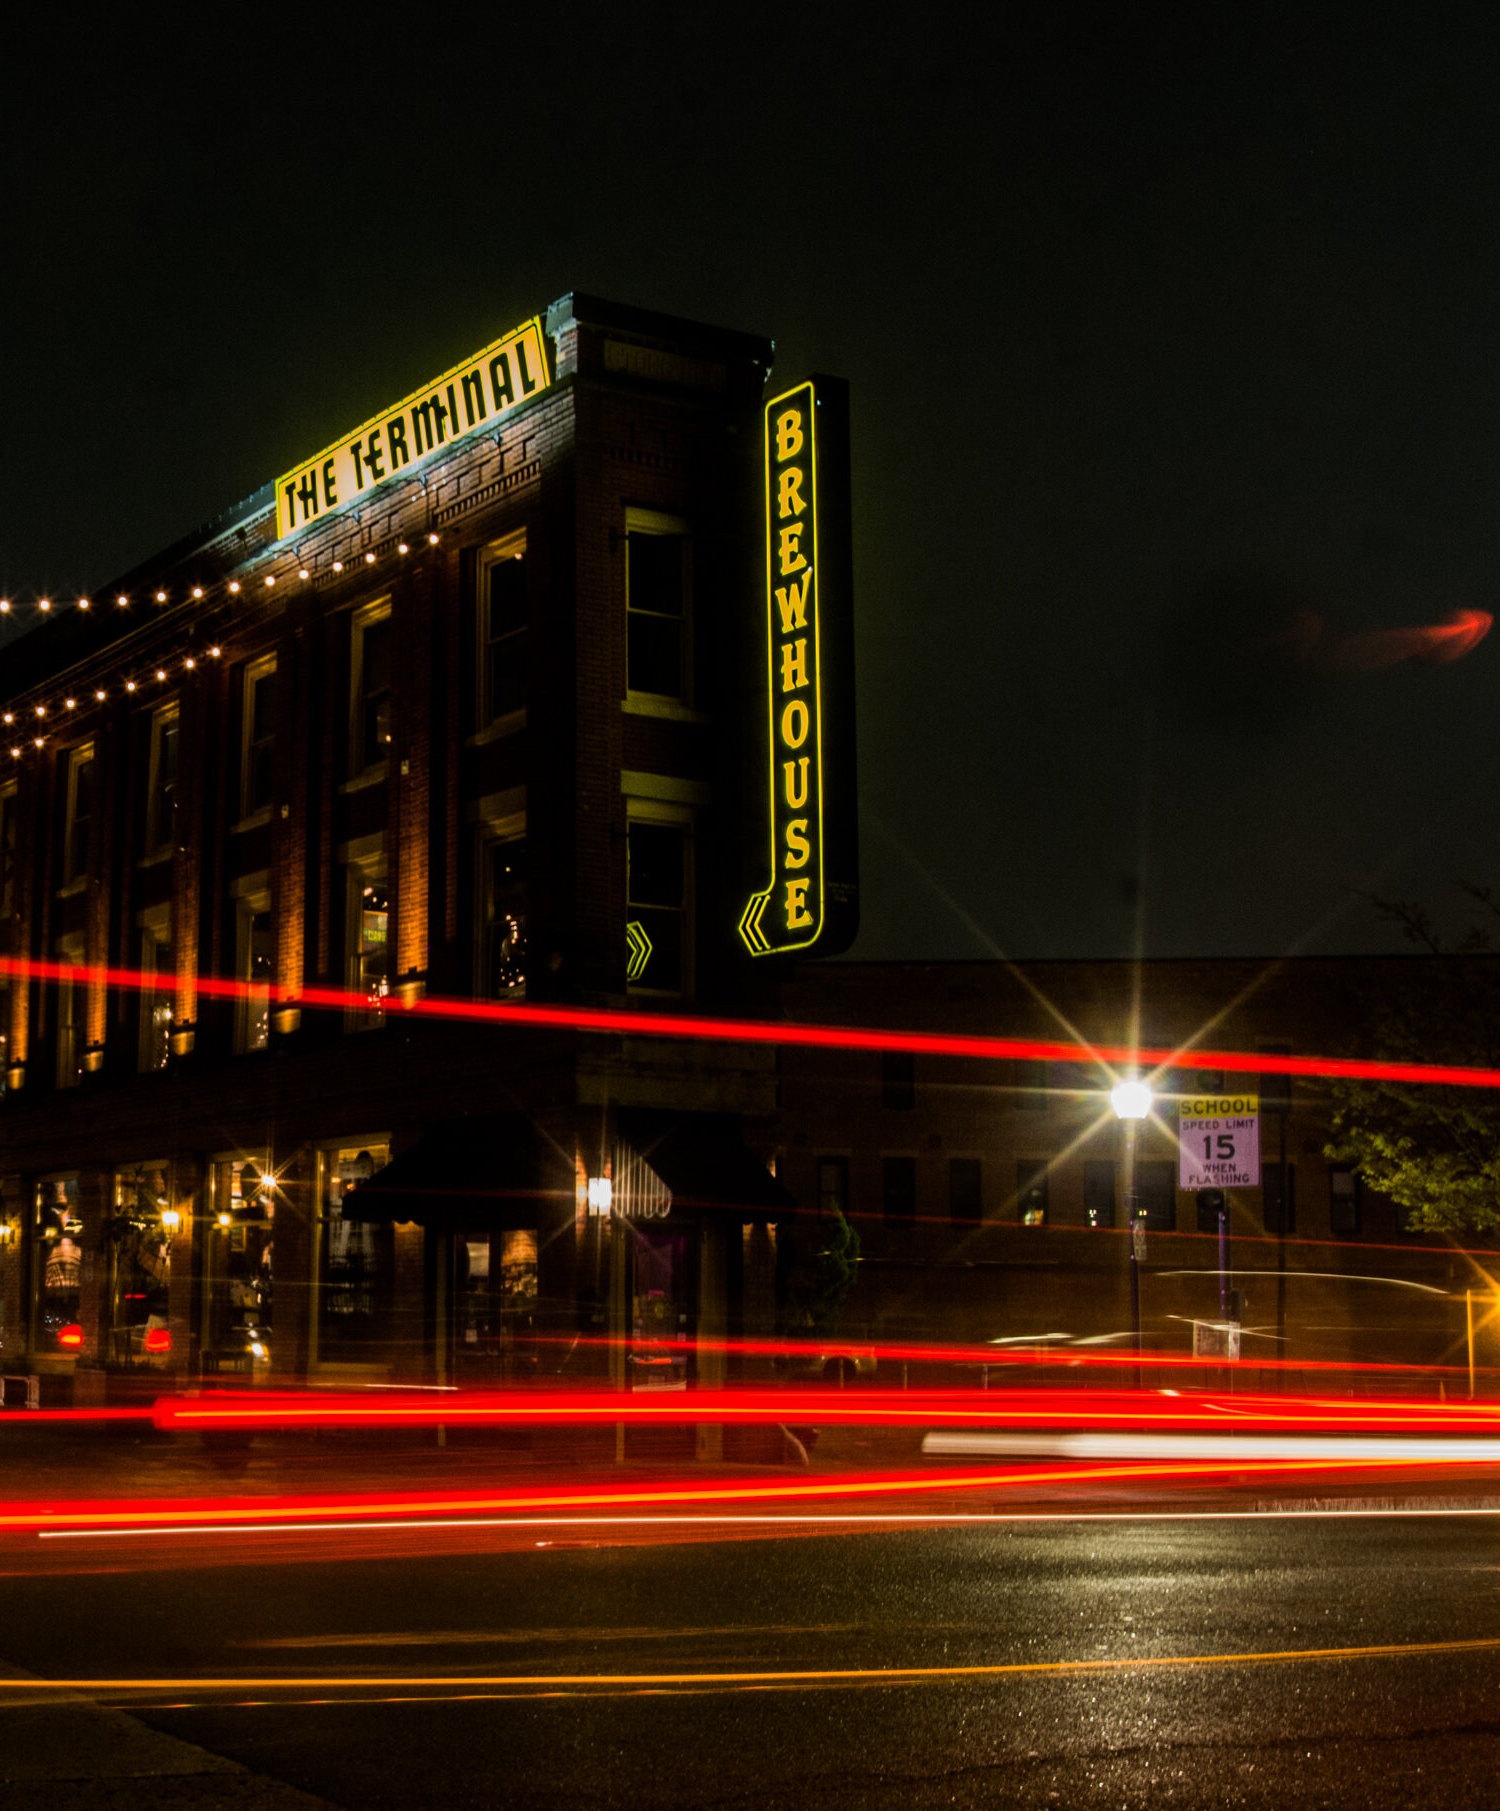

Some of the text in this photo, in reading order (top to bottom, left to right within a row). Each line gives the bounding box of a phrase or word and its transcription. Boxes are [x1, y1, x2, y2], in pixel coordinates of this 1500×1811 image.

[285, 339, 536, 529] THE TERMINAL
[775, 409, 814, 930] BREWHOUSE
[1181, 1098, 1257, 1115] SCHOOL
[1183, 1119, 1255, 1130] SPEED LIMIT
[1203, 1134, 1236, 1160] 15
[1203, 1163, 1237, 1173] WHEN
[1189, 1174, 1249, 1185] FLASHING
